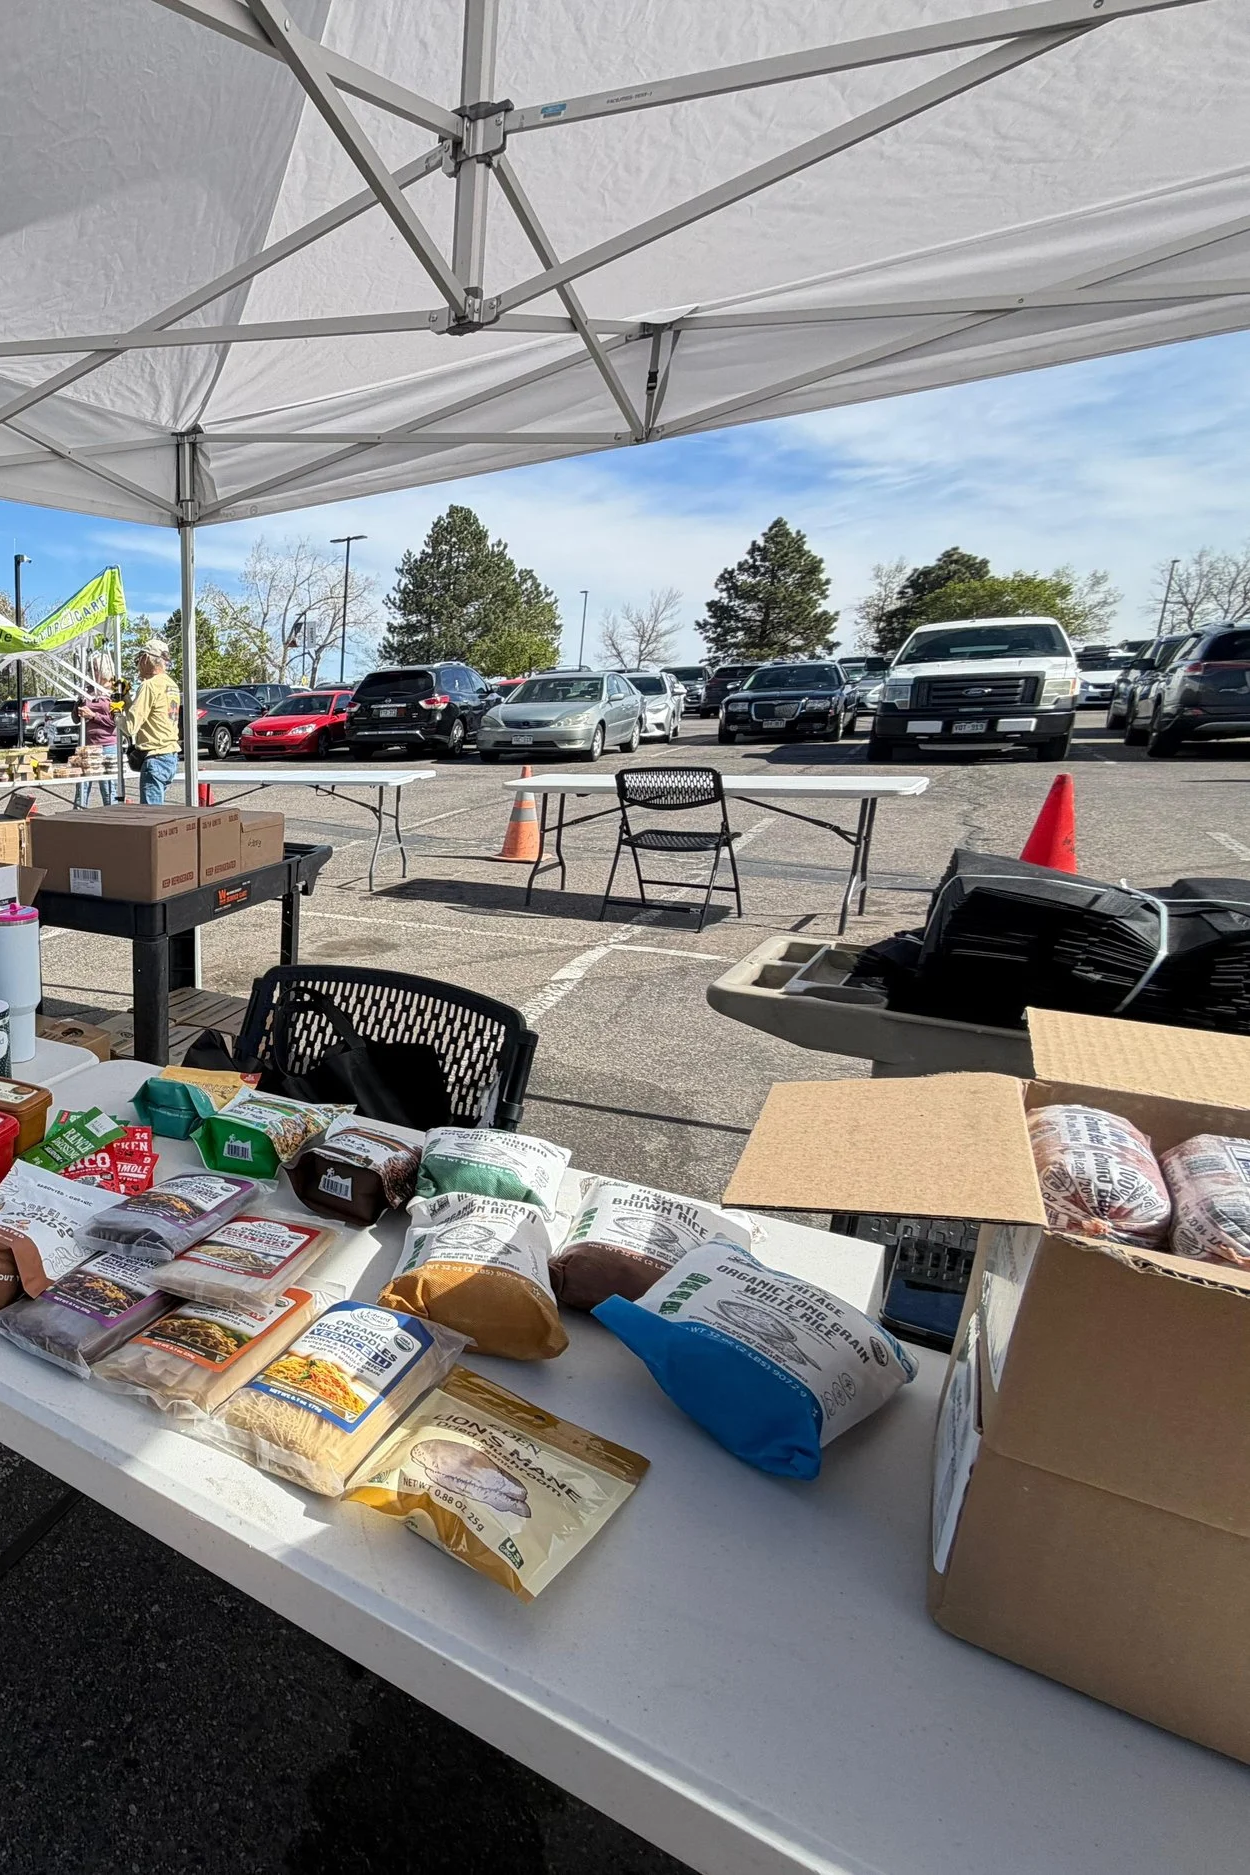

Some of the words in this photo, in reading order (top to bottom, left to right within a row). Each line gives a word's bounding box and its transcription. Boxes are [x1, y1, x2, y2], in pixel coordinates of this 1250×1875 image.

[51, 1137, 80, 1160] DRESSING
[62, 1128, 95, 1154] RANCH
[113, 1141, 148, 1152] CKEN
[69, 1152, 110, 1172] ACO
[1093, 1153, 1113, 1185] Ground
[482, 1200, 537, 1224] BASMATI
[490, 1206, 519, 1220] RICE
[612, 1198, 672, 1216] BROWN
[677, 1212, 708, 1240] RICE
[631, 1193, 699, 1219] BASMATI
[241, 1227, 285, 1239] ORGANIC
[604, 1245, 620, 1254] WT
[441, 1264, 452, 1272] 32
[716, 1265, 785, 1297] ORGANIC
[786, 1293, 829, 1322] LONG
[829, 1321, 871, 1364] GRAIN
[743, 1284, 798, 1313] WHITE
[799, 1312, 837, 1340] RICE
[317, 1322, 343, 1334] RICE
[343, 1328, 397, 1362] NOODLES
[336, 1320, 389, 1344] ORGANIC
[304, 1335, 331, 1346] BROWN
[340, 1343, 365, 1361] WHITE
[365, 1360, 386, 1373] RICE
[311, 1329, 389, 1368] VERMICELLI
[689, 1326, 705, 1334] WT
[708, 1330, 720, 1339] 32
[747, 1352, 771, 1371] LBS)
[772, 1368, 801, 1392] 907.2
[340, 1350, 361, 1366] WHOLE
[361, 1364, 381, 1377] GRAIN
[433, 1414, 505, 1447] LION'S
[509, 1448, 582, 1504] MANE
[435, 1421, 477, 1438] Dried
[480, 1438, 562, 1498] Mushroom
[472, 1440, 514, 1472] Organic
[403, 1476, 417, 1487] NET
[418, 1481, 432, 1492] WT
[434, 1490, 454, 1505] 0.88
[455, 1501, 467, 1514] OZ
[467, 1512, 485, 1533] 25g
[505, 1540, 522, 1563] US
